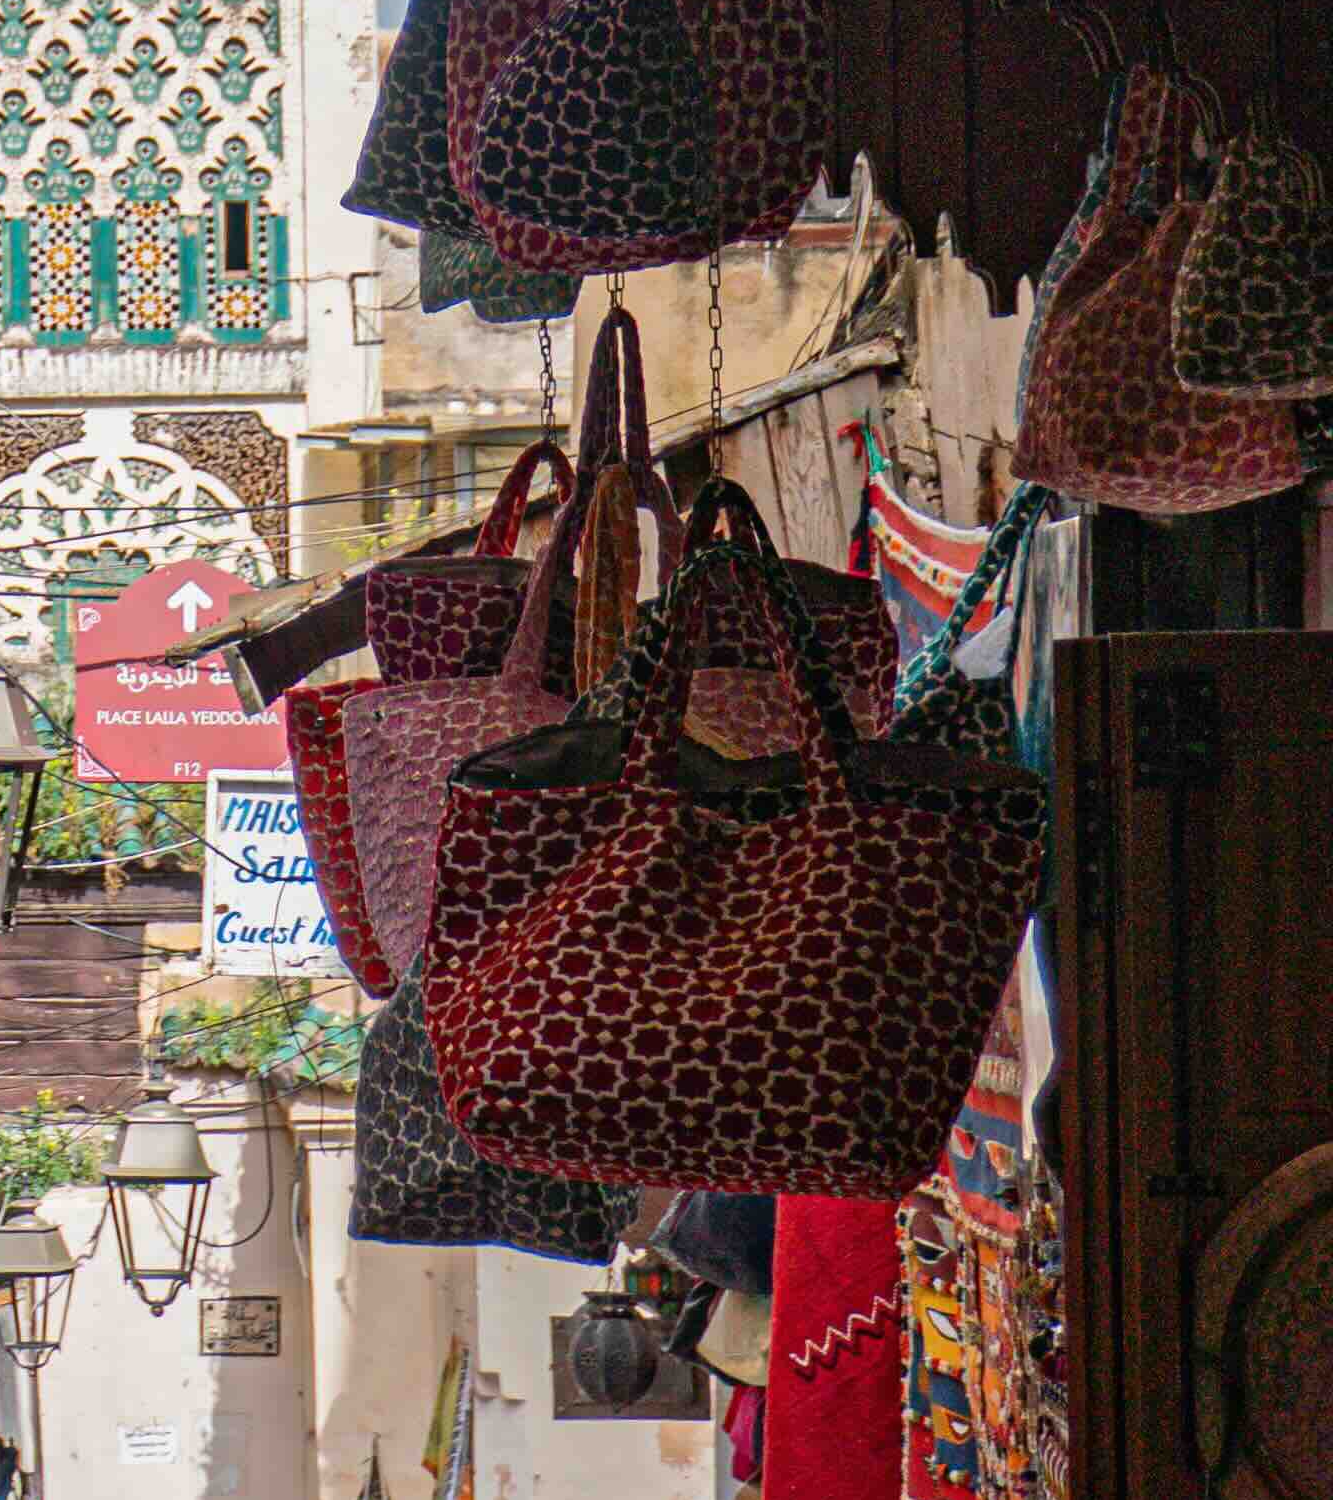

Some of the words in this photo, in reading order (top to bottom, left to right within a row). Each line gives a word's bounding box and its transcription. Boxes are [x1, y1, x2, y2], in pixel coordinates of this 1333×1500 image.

[96, 710, 141, 725] PLACE
[145, 710, 187, 725] LALLA
[174, 762, 202, 777] F12
[221, 797, 301, 835] MAIS
[216, 911, 306, 944] Guest
